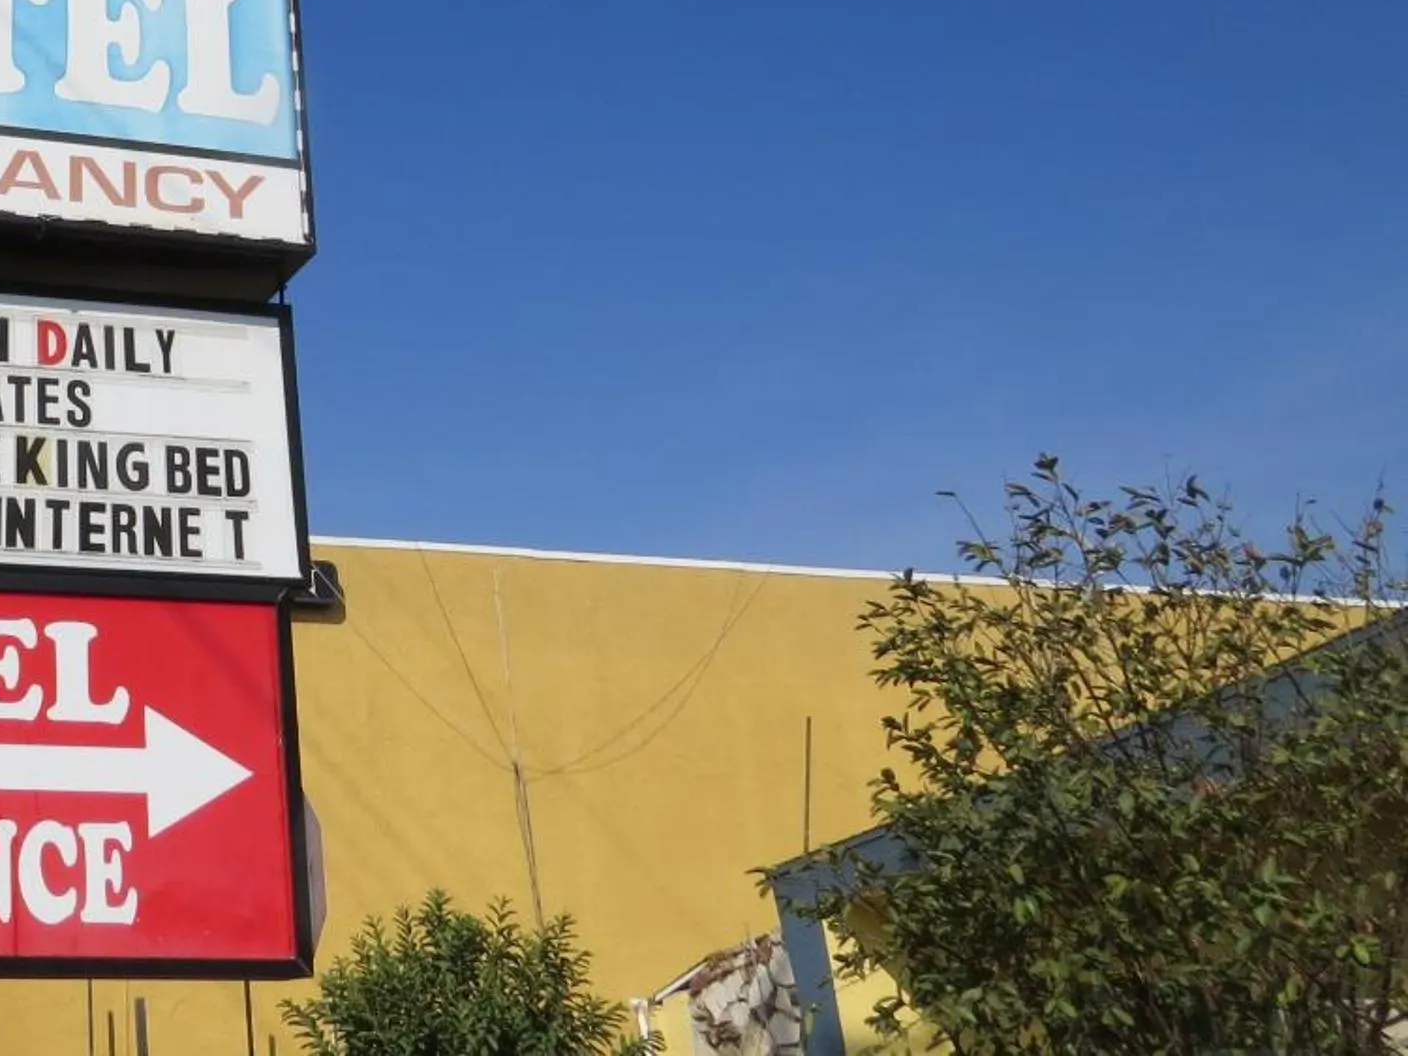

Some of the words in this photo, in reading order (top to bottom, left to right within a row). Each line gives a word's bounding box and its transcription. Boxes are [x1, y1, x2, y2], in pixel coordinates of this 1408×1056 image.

[37, 319, 176, 374] DAILY
[16, 435, 150, 492] KING
[165, 445, 250, 498] BED
